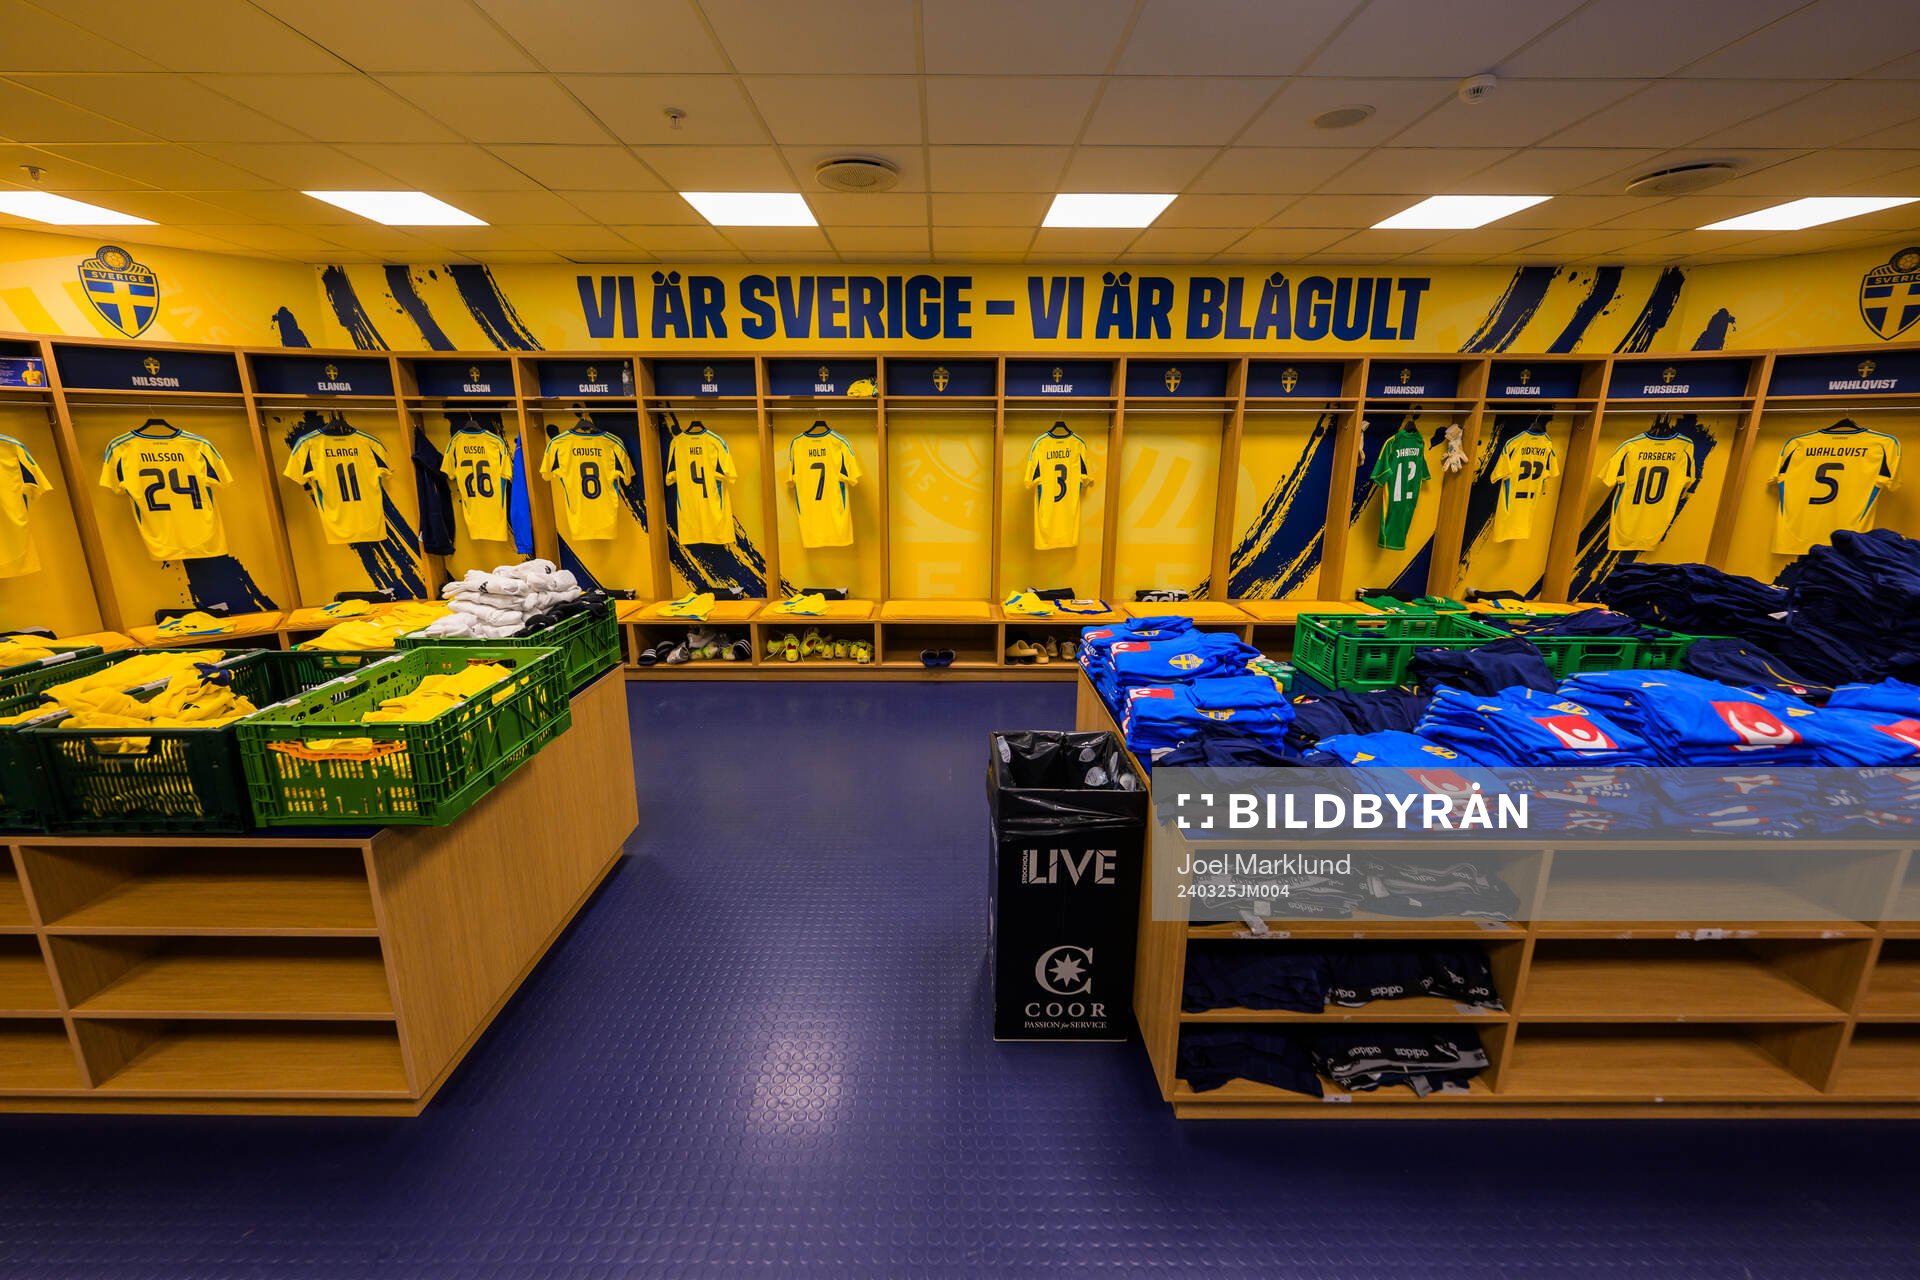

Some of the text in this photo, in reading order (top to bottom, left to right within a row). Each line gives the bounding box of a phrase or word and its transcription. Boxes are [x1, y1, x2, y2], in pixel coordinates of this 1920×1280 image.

[90, 271, 145, 283] SVERIGE
[576, 276, 639, 339] VI
[651, 270, 728, 339] ÄR
[739, 275, 972, 340] SVERIGE
[1028, 277, 1085, 339] VI
[1095, 271, 1174, 339] ÄR
[1186, 271, 1431, 341] BLÅGULT
[132, 376, 180, 388] NILSSON
[318, 382, 352, 391] ELANGA
[1828, 379, 1898, 390] WAHLQVIST
[463, 384, 491, 392] OLSSON
[579, 384, 609, 392] CAJUSTE
[701, 384, 718, 392] HIEN
[814, 383, 834, 392] HOLM
[1041, 384, 1073, 393] LINDELÖF
[1383, 386, 1424, 395] JOHANSSON
[1506, 386, 1541, 395] ONDREJKA
[1643, 384, 1690, 394] FORSBERG
[325, 448, 358, 457] ELANGA
[463, 446, 486, 455] OLSSON
[572, 447, 602, 457] CAJUSTE
[808, 448, 827, 457] HOLM
[1806, 447, 1868, 457] WAHLQVIST
[141, 452, 185, 463] NILSSON
[1638, 451, 1677, 461] FORSBERG
[336, 462, 362, 502] 11
[460, 460, 495, 498] 26
[580, 462, 602, 500] 8
[690, 460, 708, 499] 4
[810, 462, 826, 501] 7
[1054, 464, 1068, 503] 3
[1808, 462, 1845, 505] 5
[139, 467, 203, 512] 24
[1632, 465, 1670, 505] 10
[1029, 849, 1117, 886] LIVE
[1025, 1002, 1107, 1017] COOR
[1024, 1021, 1060, 1029] PASSION
[1070, 1021, 1107, 1029] SERVICE
